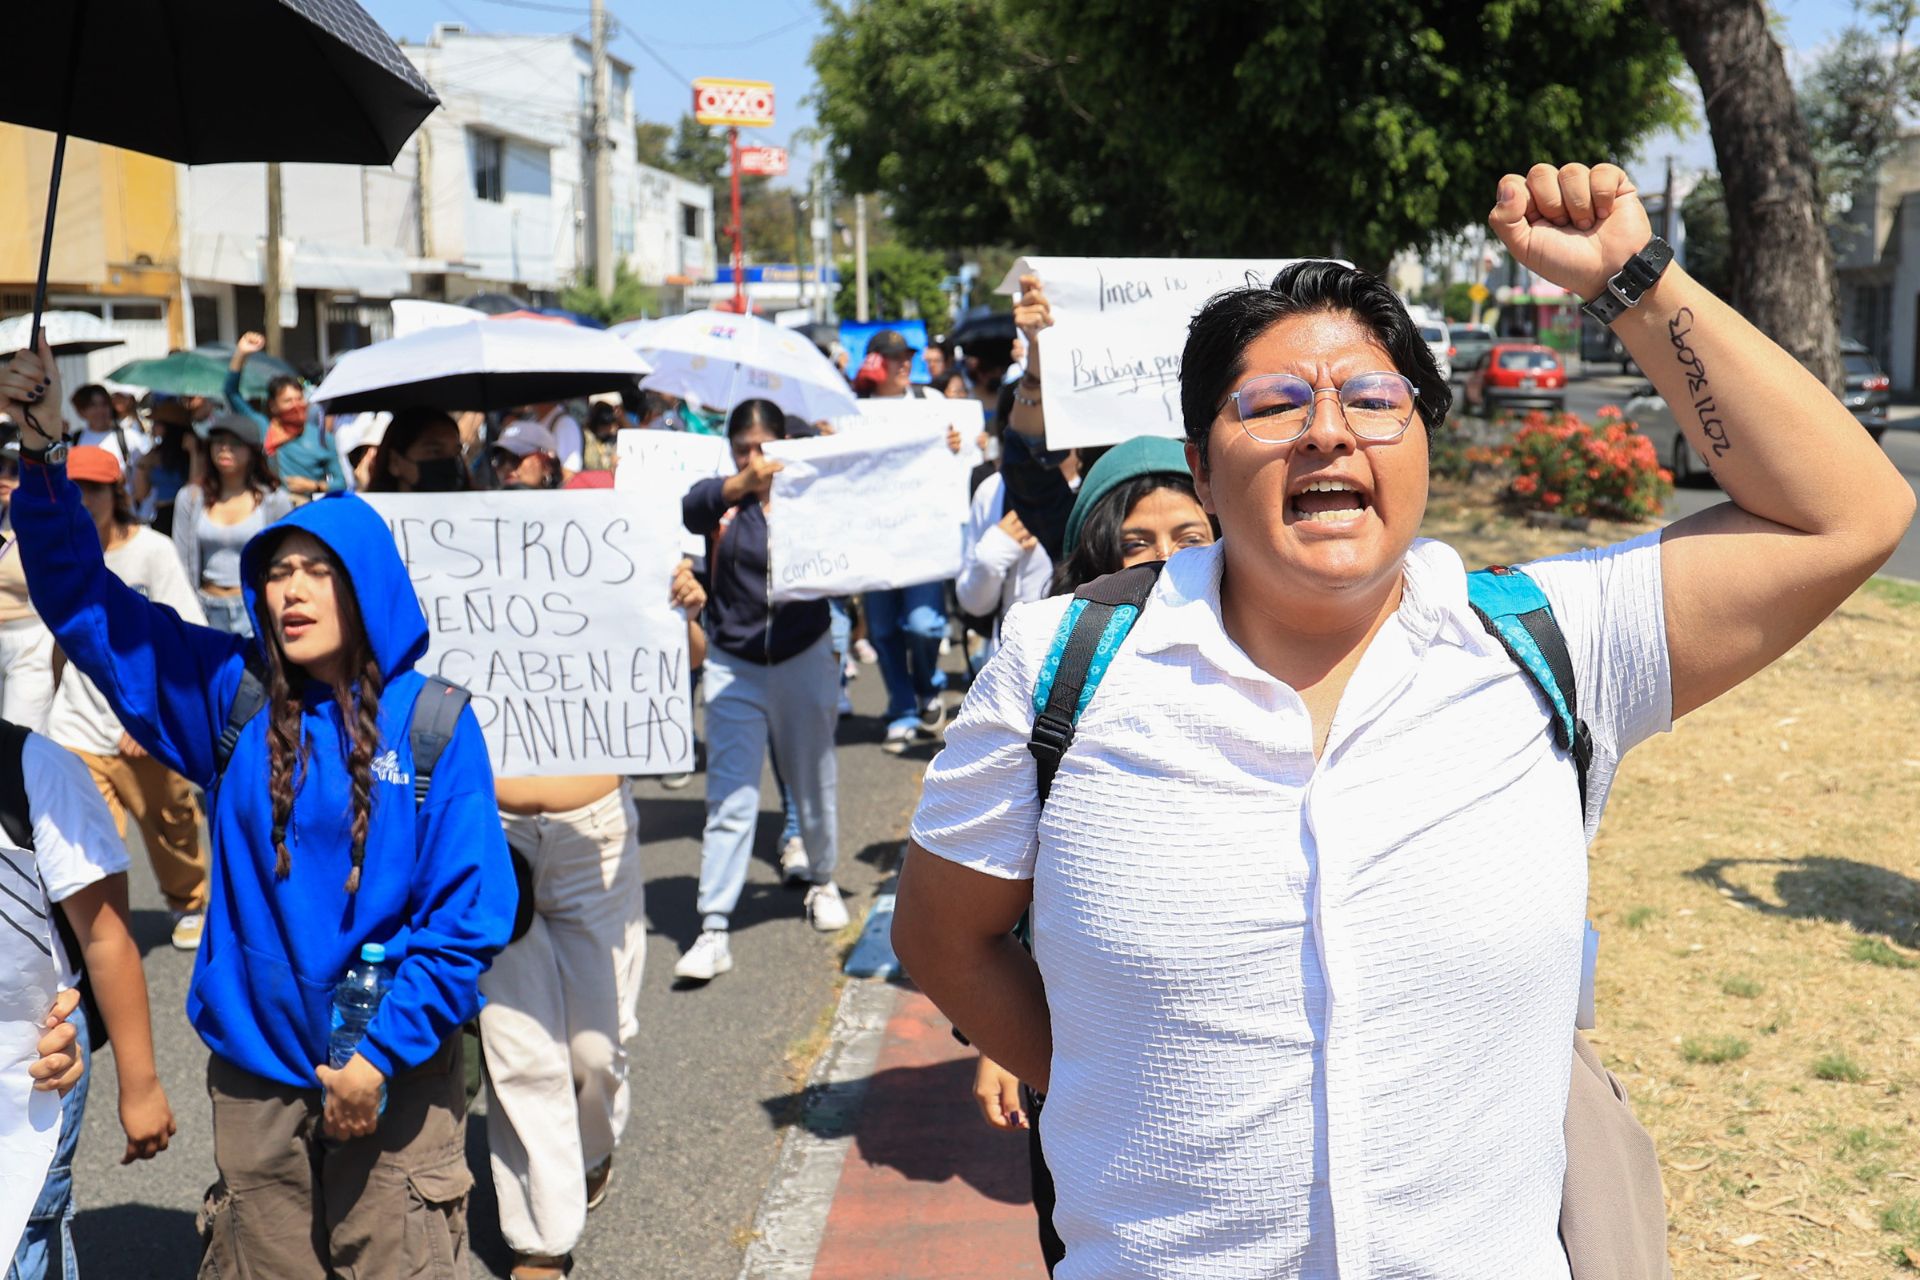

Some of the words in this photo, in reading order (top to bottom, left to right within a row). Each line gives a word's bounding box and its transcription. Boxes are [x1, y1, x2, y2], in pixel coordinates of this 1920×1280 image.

[696, 88, 774, 119] OXXO
[389, 517, 635, 585] ESTROS
[419, 586, 589, 638] EÑOS
[437, 648, 612, 694] CABEN
[630, 646, 681, 696] EN
